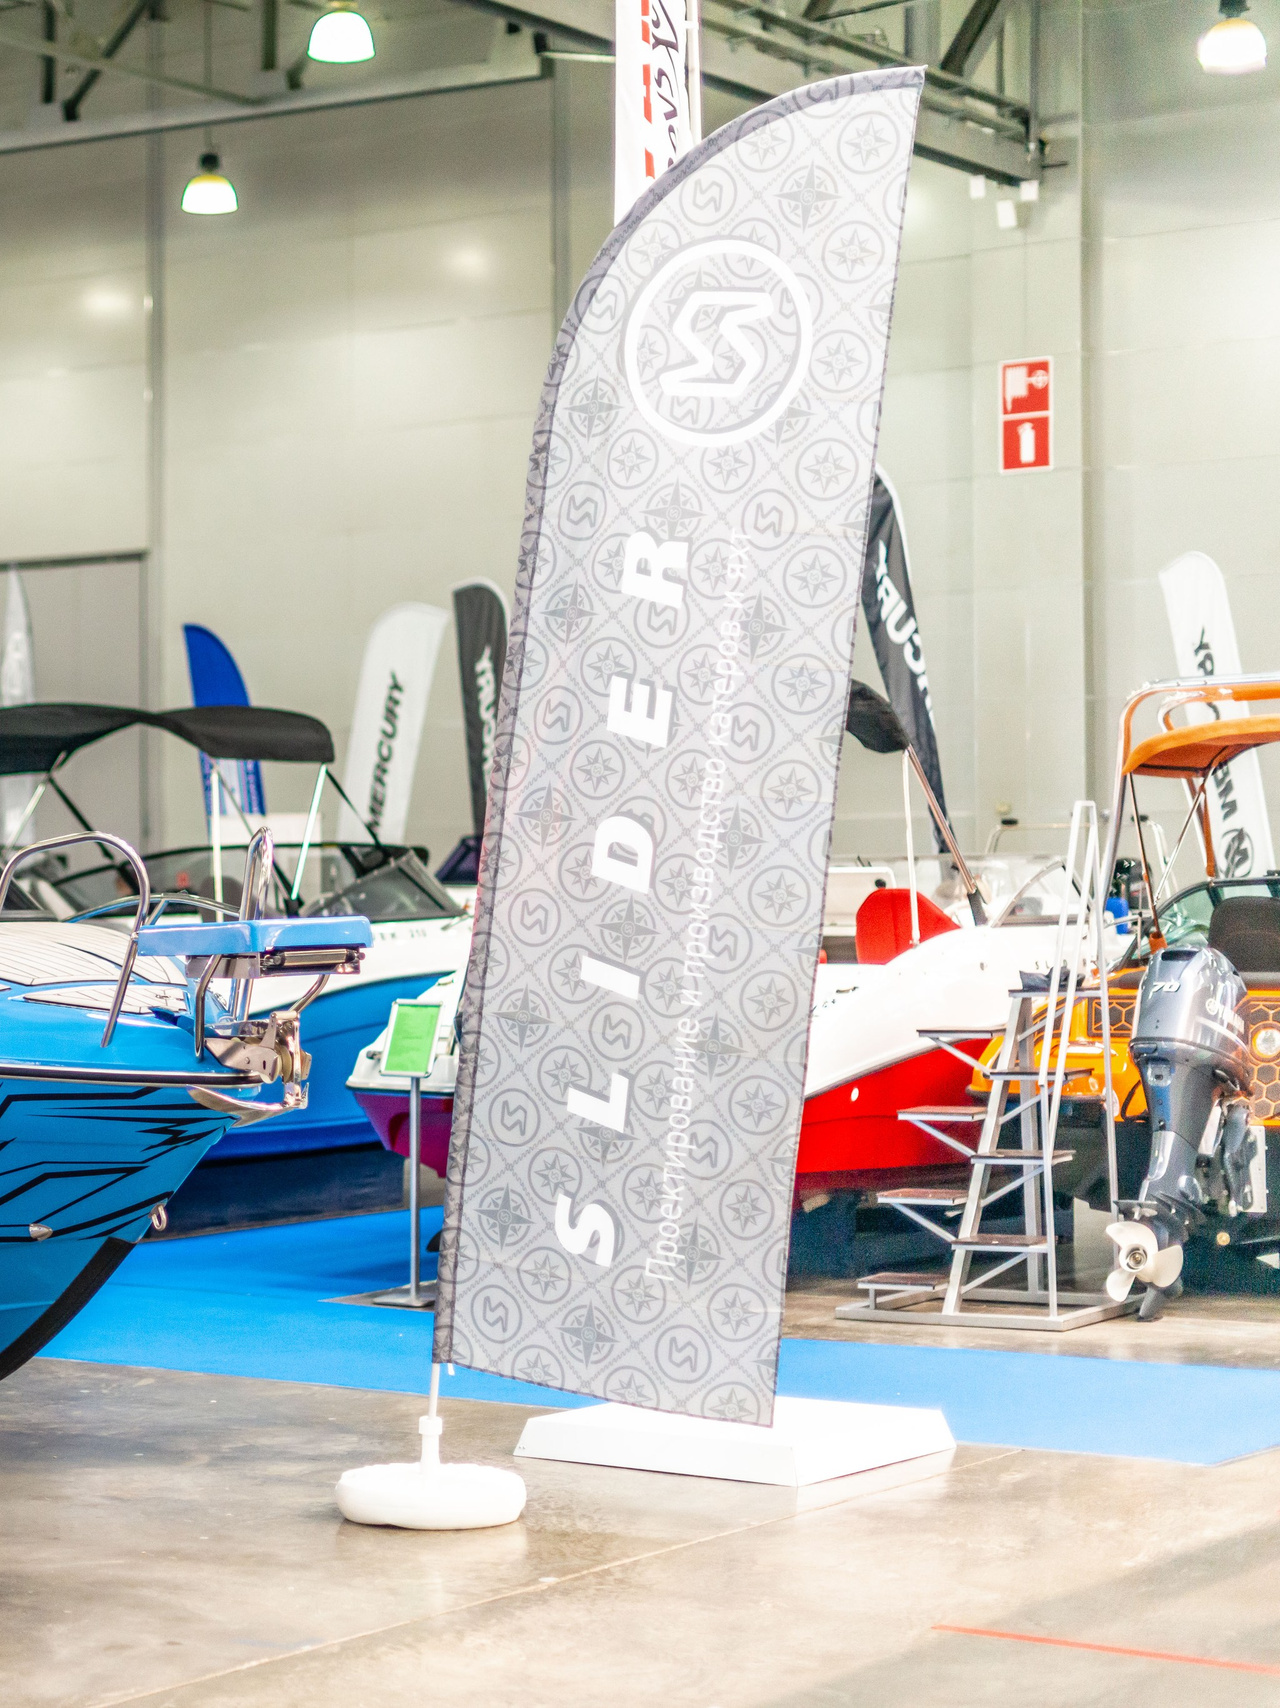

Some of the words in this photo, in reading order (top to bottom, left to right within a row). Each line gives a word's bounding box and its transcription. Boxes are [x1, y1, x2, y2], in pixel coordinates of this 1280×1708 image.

[726, 527, 752, 580] яхт
[723, 590, 746, 609] и
[707, 620, 745, 747] катеров
[554, 531, 689, 1268] SLIDER
[683, 758, 726, 978] производство
[680, 988, 704, 1007] и
[1147, 981, 1181, 1000] 70
[644, 1017, 700, 1281] Проектирование
